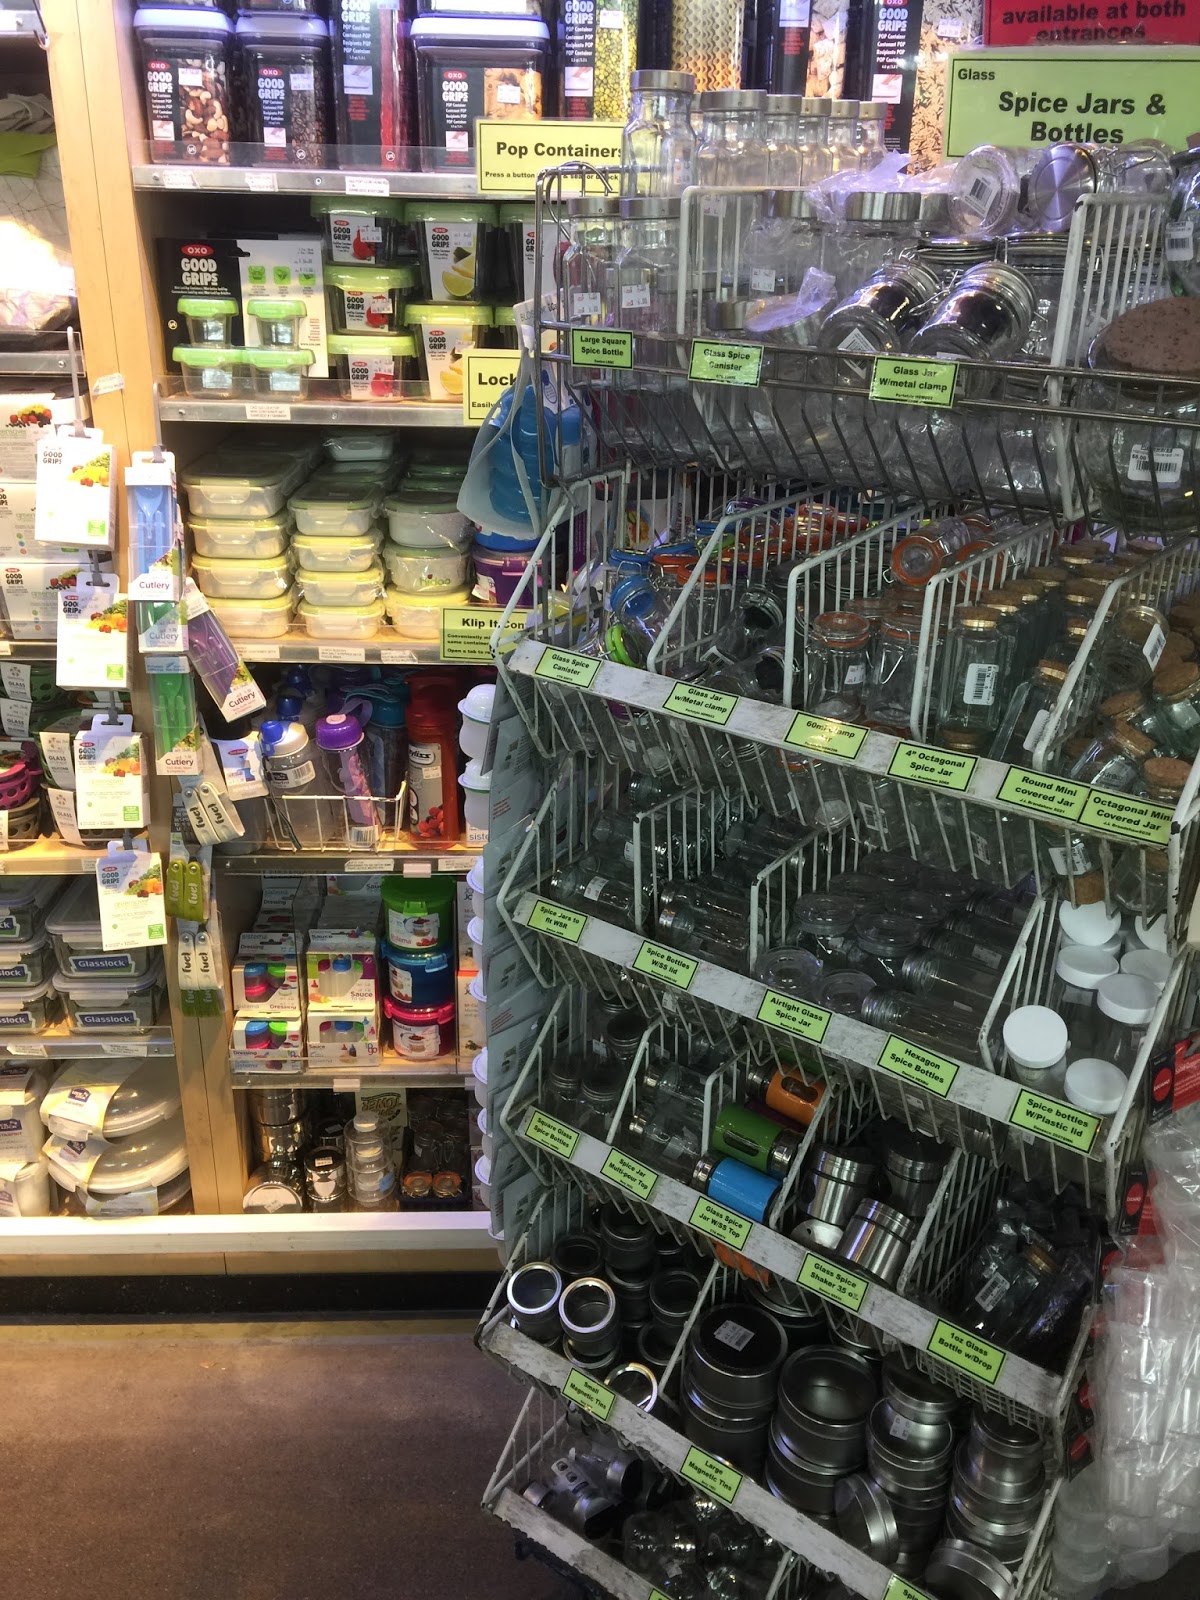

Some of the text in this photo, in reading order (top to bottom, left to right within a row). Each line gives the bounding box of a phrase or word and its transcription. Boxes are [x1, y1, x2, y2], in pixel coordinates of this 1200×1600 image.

[565, 1, 593, 12] GOOD
[879, 8, 908, 20] GOOD
[1003, 0, 1186, 24] available at both
[341, 11, 370, 23] GRIPS
[565, 13, 593, 24] GRIPS
[878, 20, 907, 31] GRIPS
[1037, 25, 1146, 42] entrances
[147, 71, 173, 82] GOOD
[958, 69, 995, 80] Glass
[148, 82, 173, 93] GRIPS
[257, 78, 285, 89] GOOD
[442, 81, 468, 92] GOOD
[258, 89, 285, 100] GRIPS
[442, 92, 468, 102] GRIPS
[999, 92, 1166, 116] Spice Jars &
[1031, 122, 1124, 144] Bottles
[497, 142, 528, 159] Pop
[187, 247, 208, 255] OXO
[181, 258, 217, 272] GOOD
[182, 272, 218, 286] GRIPS
[580, 336, 627, 346] Large Square
[581, 347, 624, 356] Spice Bottle
[704, 349, 750, 360] Glass Spice
[709, 361, 742, 371] Canister
[894, 366, 919, 376] Glass
[880, 378, 947, 392] W/metal clamp
[43, 451, 63, 459] GOOD
[139, 582, 170, 590] Cutlery
[462, 618, 485, 629] Klip
[149, 632, 179, 641] Cutlery
[552, 653, 590, 669] Glass Spice
[553, 663, 581, 676] Canister
[228, 691, 255, 709] Cutlery
[688, 688, 723, 702] Glass Jar
[674, 695, 704, 707] w/Metal
[704, 702, 727, 713] clamp
[165, 758, 194, 767] Cutlery
[918, 752, 966, 768] Octagonal
[910, 761, 953, 776] Spice Jar
[1021, 776, 1078, 796] Round Mini
[1015, 787, 1075, 807] covered Jar
[208, 803, 225, 824] fuel
[1093, 797, 1148, 816] Octagonal
[190, 806, 206, 829] fuel
[1097, 809, 1140, 826] Covered
[1143, 821, 1161, 831] Jar
[169, 880, 180, 901] fuel
[188, 882, 198, 905] fuel
[540, 906, 557, 917] Spice
[558, 913, 572, 921] Jars
[554, 920, 568, 929] WSR
[77, 960, 126, 968] Glasslock
[181, 952, 191, 973] fuel
[198, 952, 209, 973] fuel
[646, 947, 690, 970] Spice Bottles
[651, 959, 678, 975] W/SS lid
[770, 997, 823, 1021] Airtight Glass
[775, 1009, 812, 1027] Spice Jar
[904, 1048, 941, 1070] Hexagon
[890, 1053, 945, 1083] Spice Bottles
[1027, 1098, 1089, 1128] Spice bottles
[537, 1117, 573, 1141] Square Glass
[1025, 1109, 1083, 1137] W/Plastic lid
[533, 1125, 549, 1137] Spice
[549, 1133, 570, 1149] Bottles
[618, 1158, 647, 1178] Spice Jar
[608, 1162, 638, 1183] Multi-pour
[637, 1180, 649, 1191] Top
[705, 1205, 744, 1229] Glass Spice
[698, 1213, 711, 1223] Jar
[728, 1227, 741, 1239] Top
[810, 1271, 836, 1289] Shaker
[813, 1262, 858, 1289] Glass Spice
[950, 1332, 989, 1357] 1oz Glass
[937, 1337, 993, 1371] Bottle w/Drop
[569, 1382, 607, 1410] Magnetic Tins
[583, 1381, 600, 1395] Small
[704, 1460, 724, 1475] Large
[688, 1460, 719, 1483] Magnetic
[717, 1478, 733, 1492] Tins
